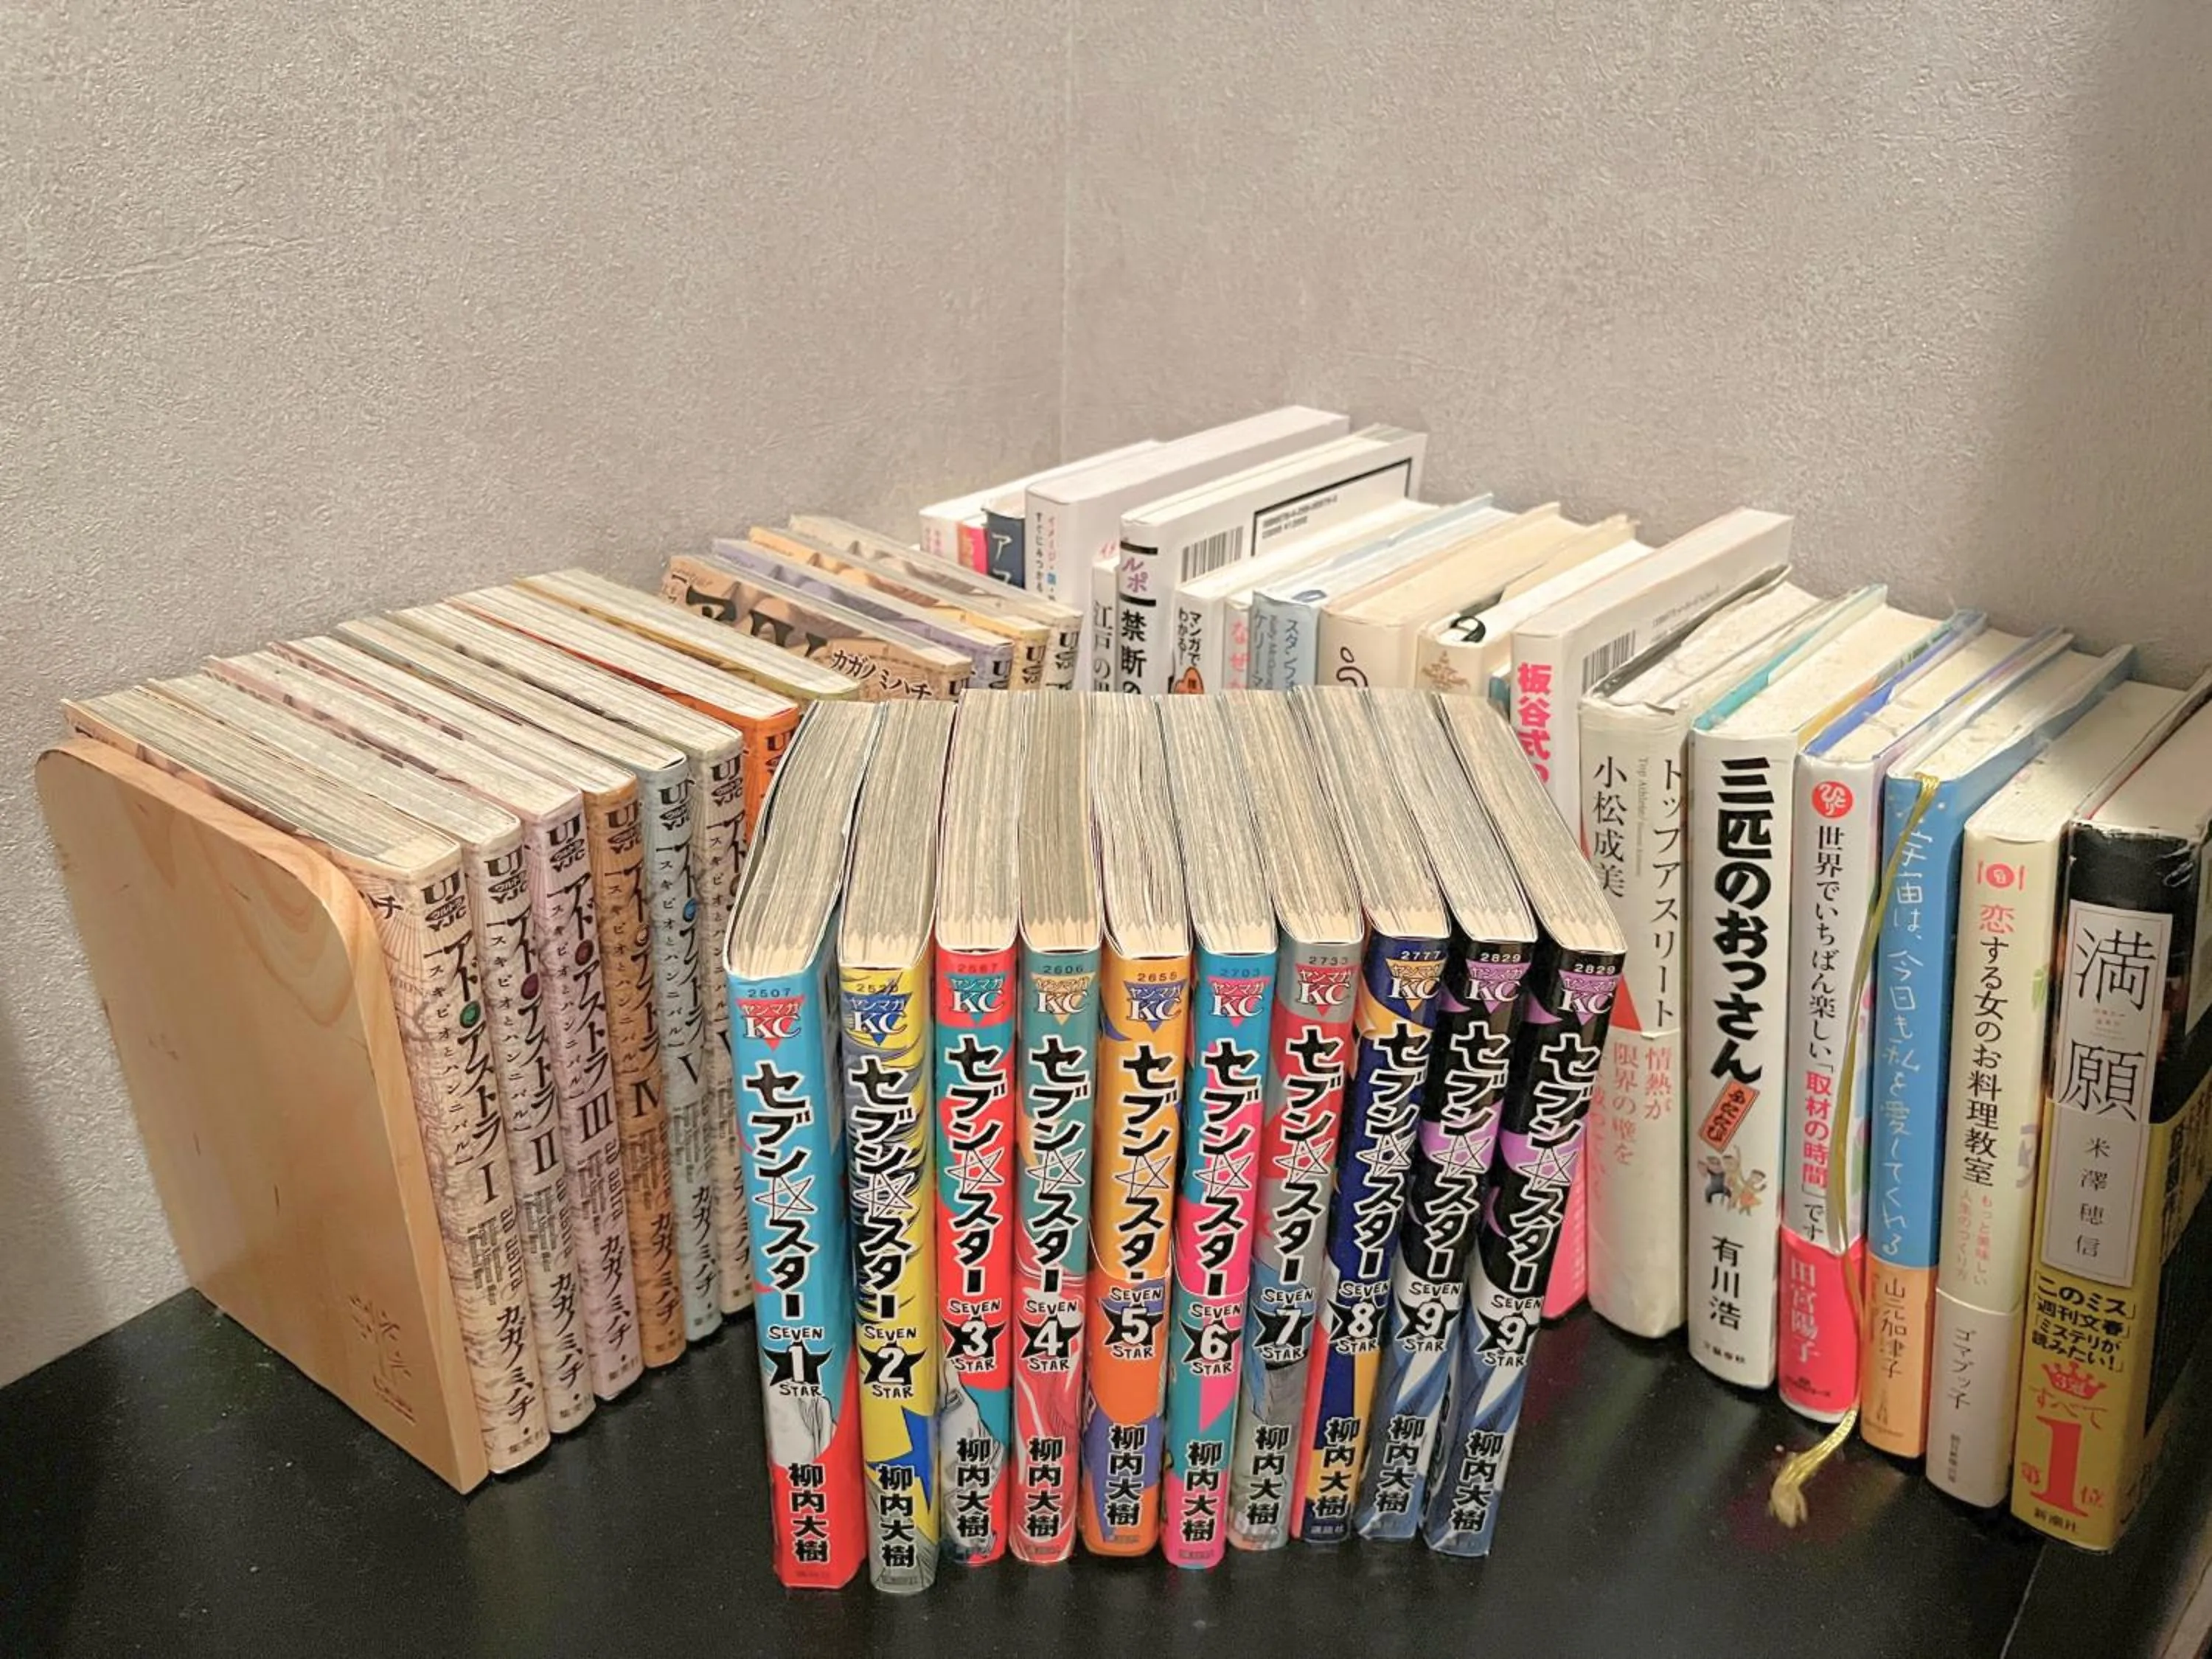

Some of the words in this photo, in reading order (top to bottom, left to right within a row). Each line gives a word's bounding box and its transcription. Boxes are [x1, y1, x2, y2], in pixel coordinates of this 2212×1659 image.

[1122, 557, 1149, 593] ルポ
[1188, 611, 1203, 667] マンガで
[1593, 755, 1627, 898] 小松成美
[420, 870, 461, 905] UJ
[1711, 757, 1775, 1084] 三匹のおっさん
[1400, 950, 1441, 960] 2777
[1480, 953, 1522, 962] 2829
[1043, 965, 1084, 974] 2606
[1574, 963, 1616, 975] 2829
[747, 987, 791, 998] 2507
[1298, 982, 1352, 1005] KC
[1388, 977, 1441, 1000] KC
[1465, 978, 1523, 1001] KC
[1558, 988, 1614, 1014] KC
[951, 991, 1004, 1013] KC
[1036, 991, 1088, 1013] KC
[1126, 998, 1182, 1022] KC
[1209, 995, 1265, 1018] KC
[744, 1015, 801, 1040] KC
[851, 1011, 908, 1034] KC
[1963, 904, 2016, 1188] 恋する女のお料理教室
[1645, 1046, 1672, 1121] 情熱が
[1612, 1042, 1639, 1166] 限界の壁を
[2075, 1136, 2111, 1258] 米澤穂信
[599, 1235, 633, 1347] カガノミハチ
[1109, 1287, 1162, 1304] SEVEN
[1261, 1287, 1315, 1304] SEVEN
[1338, 1281, 1391, 1298] SEVEN
[1408, 1281, 1462, 1298] SEVEN
[1708, 1236, 1744, 1331] 有川浩
[948, 1298, 1002, 1315] SEVEN
[1024, 1299, 1078, 1315] SEVEN
[1190, 1302, 1244, 1318] SEVEN
[1490, 1295, 1545, 1312] SEVEN
[1790, 1259, 1821, 1364] 田宮陽子
[550, 1272, 588, 1390] カガノミハチ
[1121, 1307, 1150, 1345] 5
[1276, 1309, 1301, 1347] 7
[1347, 1302, 1374, 1337] 8
[1417, 1301, 1444, 1339] 9
[768, 1326, 823, 1340] SEVEN
[863, 1326, 917, 1340] SEVEN
[961, 1319, 987, 1357] 3
[1033, 1319, 1063, 1355] 4
[1200, 1324, 1228, 1360] 6
[1335, 1338, 1380, 1353] STAR
[1404, 1338, 1447, 1352] STAR
[1498, 1315, 1527, 1352] 9
[1111, 1343, 1154, 1358] STAR
[1262, 1346, 1305, 1360] STAR
[1482, 1352, 1527, 1367] STAR
[496, 1305, 537, 1423] カガノミハチ
[787, 1345, 804, 1383] 1
[880, 1347, 905, 1385] 2
[954, 1357, 996, 1372] STAR
[1028, 1357, 1071, 1371] STAR
[1190, 1360, 1234, 1375] STAR
[779, 1384, 822, 1398] STAR
[871, 1384, 914, 1399] STAR
[1106, 1423, 1147, 1526] 柳内大樹
[1246, 1425, 1290, 1526] 柳内大樹
[1312, 1418, 1361, 1519] 柳内大樹
[1377, 1416, 1426, 1515] 柳内大樹
[957, 1438, 992, 1539] 柳内大樹
[1027, 1437, 1064, 1540] 柳内大樹
[1182, 1441, 1222, 1543] 柳内大樹
[1452, 1431, 1505, 1534] 柳内大樹
[787, 1462, 830, 1565] 柳内大樹
[878, 1465, 915, 1568] 柳内大樹
